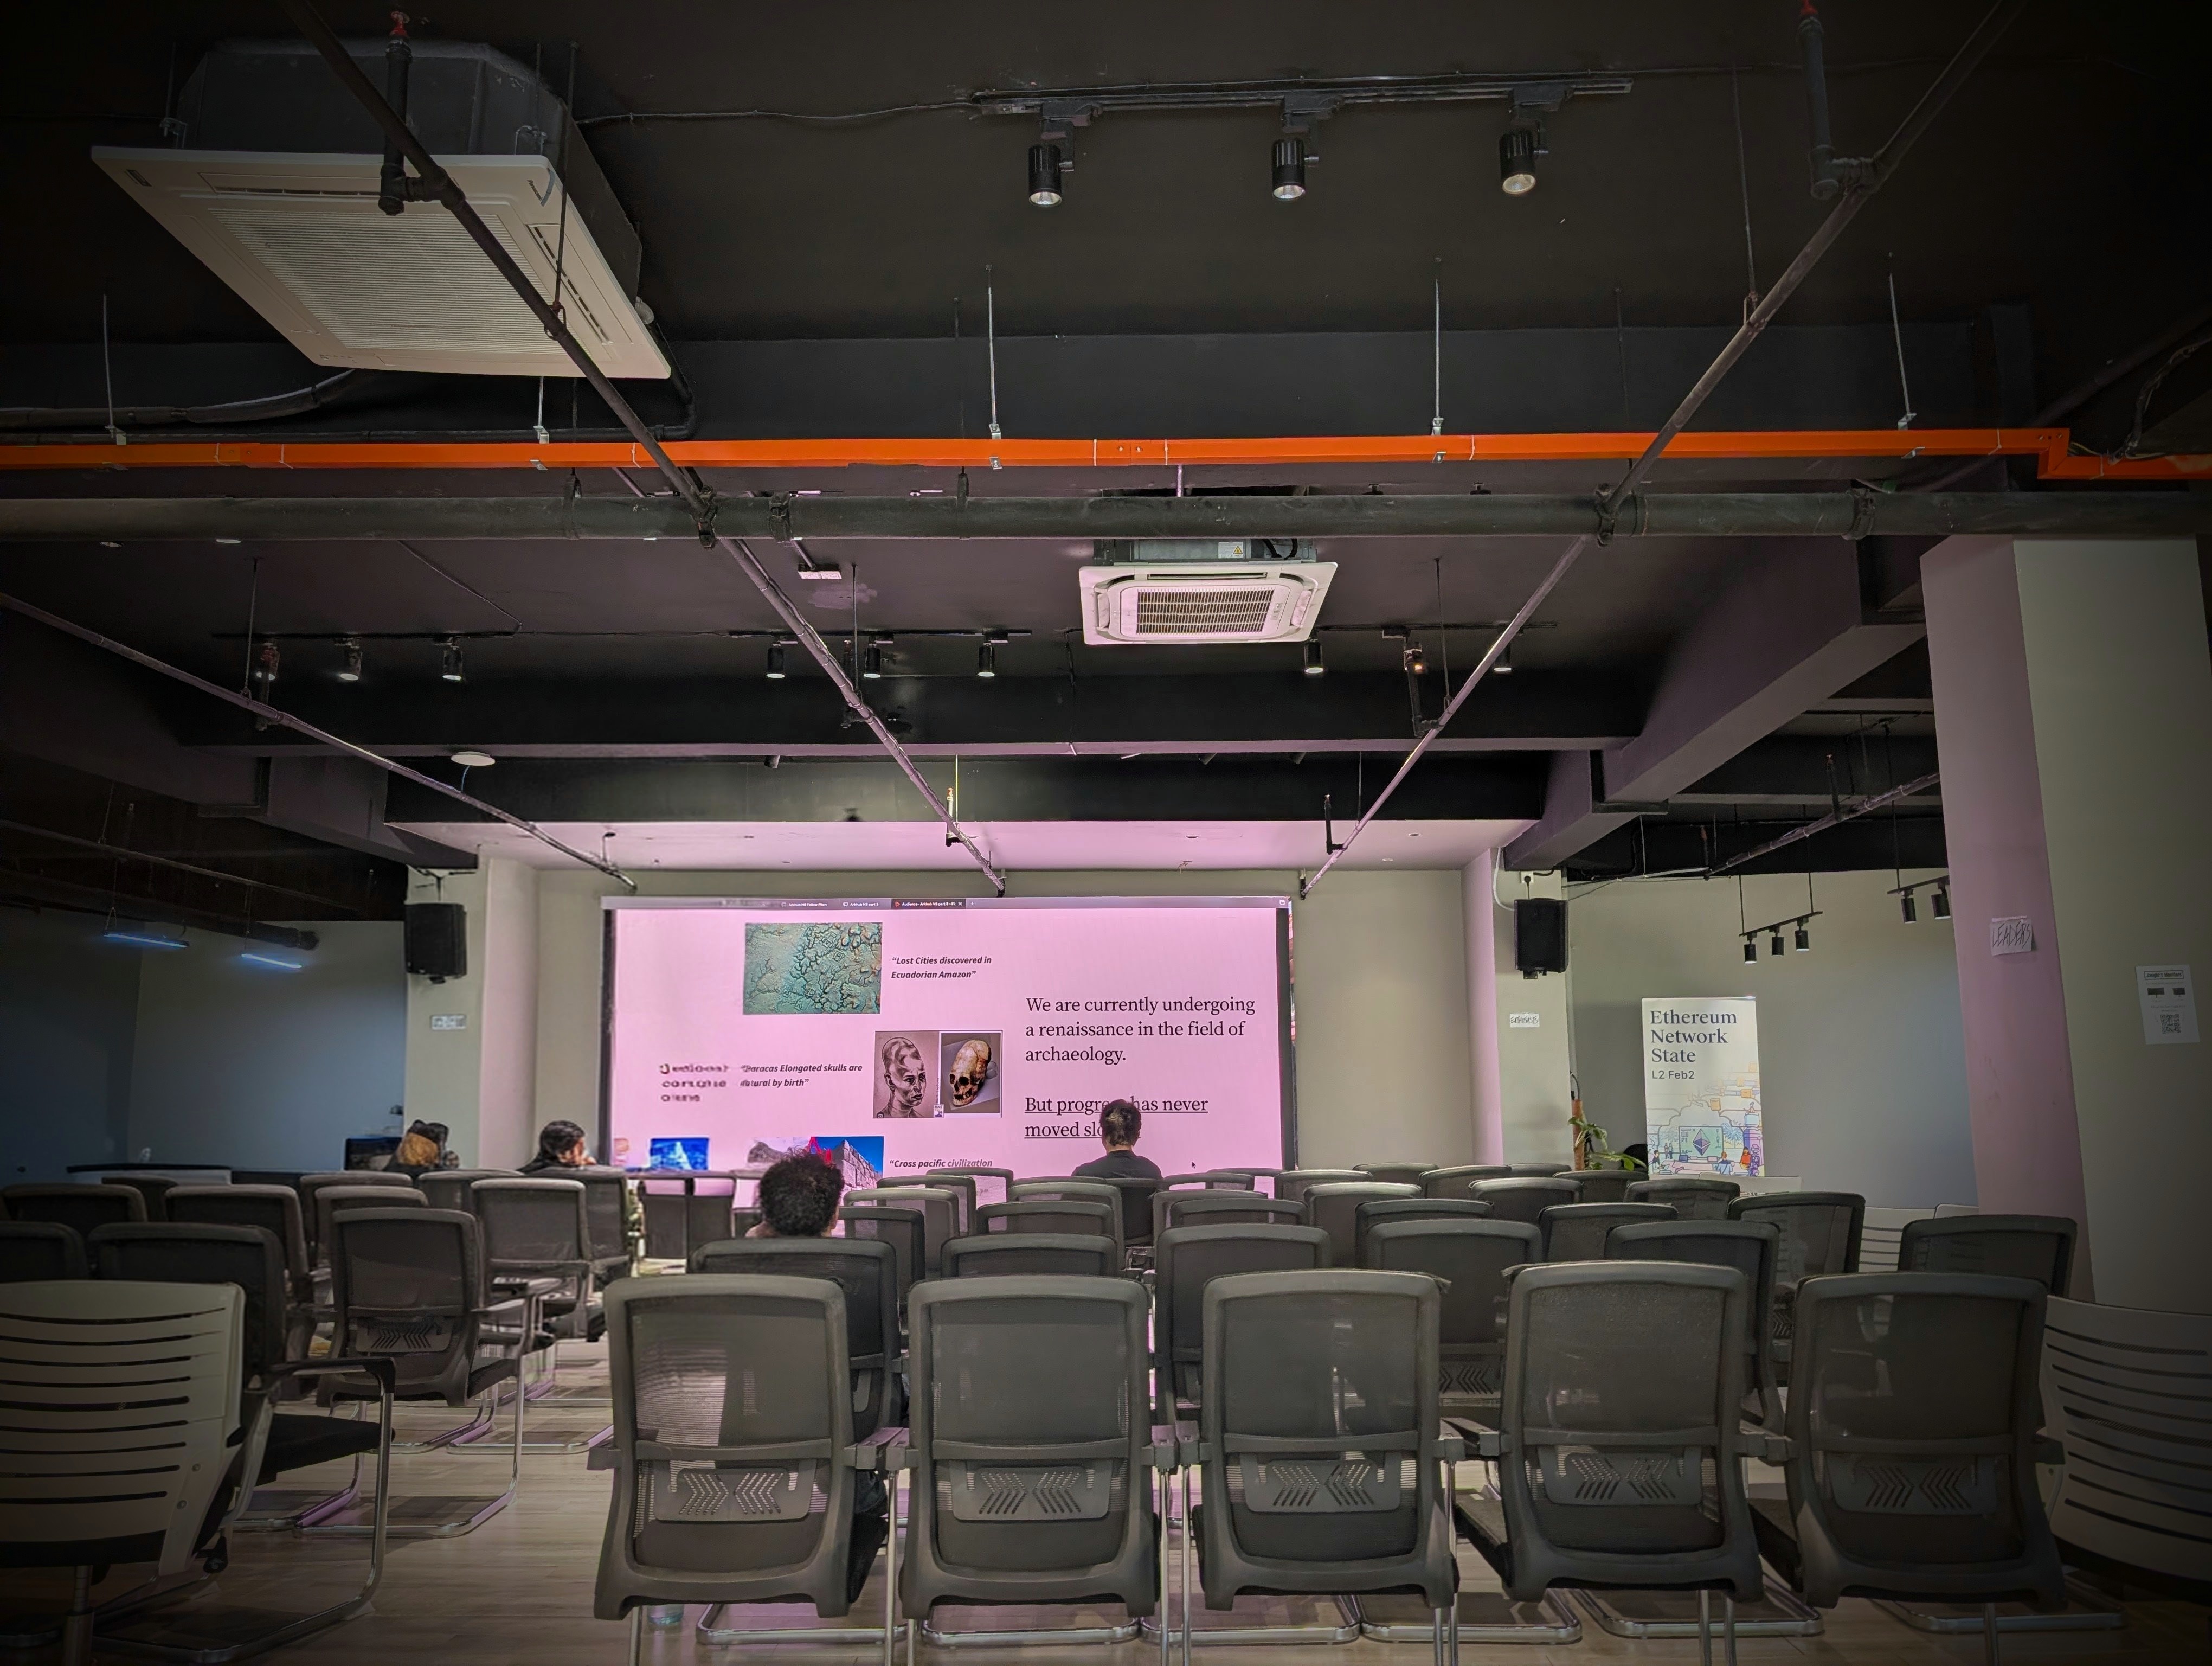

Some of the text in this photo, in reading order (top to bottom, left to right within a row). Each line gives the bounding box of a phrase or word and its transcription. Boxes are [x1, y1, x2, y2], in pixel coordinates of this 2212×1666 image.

[1992, 921, 2031, 949] LEADERS
[915, 956, 937, 964] Cities
[939, 956, 982, 964] discovered
[1026, 996, 1256, 1016] We are currently undergoing
[1650, 1009, 1738, 1024] Ethereum
[1025, 1021, 1246, 1036] a renaissance in the field of
[1651, 1028, 1729, 1043] Network
[1025, 1046, 1127, 1066] archaeology.
[1651, 1048, 1696, 1062] State
[780, 1064, 822, 1074] Elongated
[824, 1064, 847, 1072] skulls
[1652, 1071, 1695, 1079] L2 Feb2
[772, 1079, 783, 1088] by
[1025, 1095, 1208, 1116] But progre has never
[1025, 1122, 1080, 1137] moved
[917, 1159, 946, 1169] pacific
[947, 1159, 993, 1167] civilization
